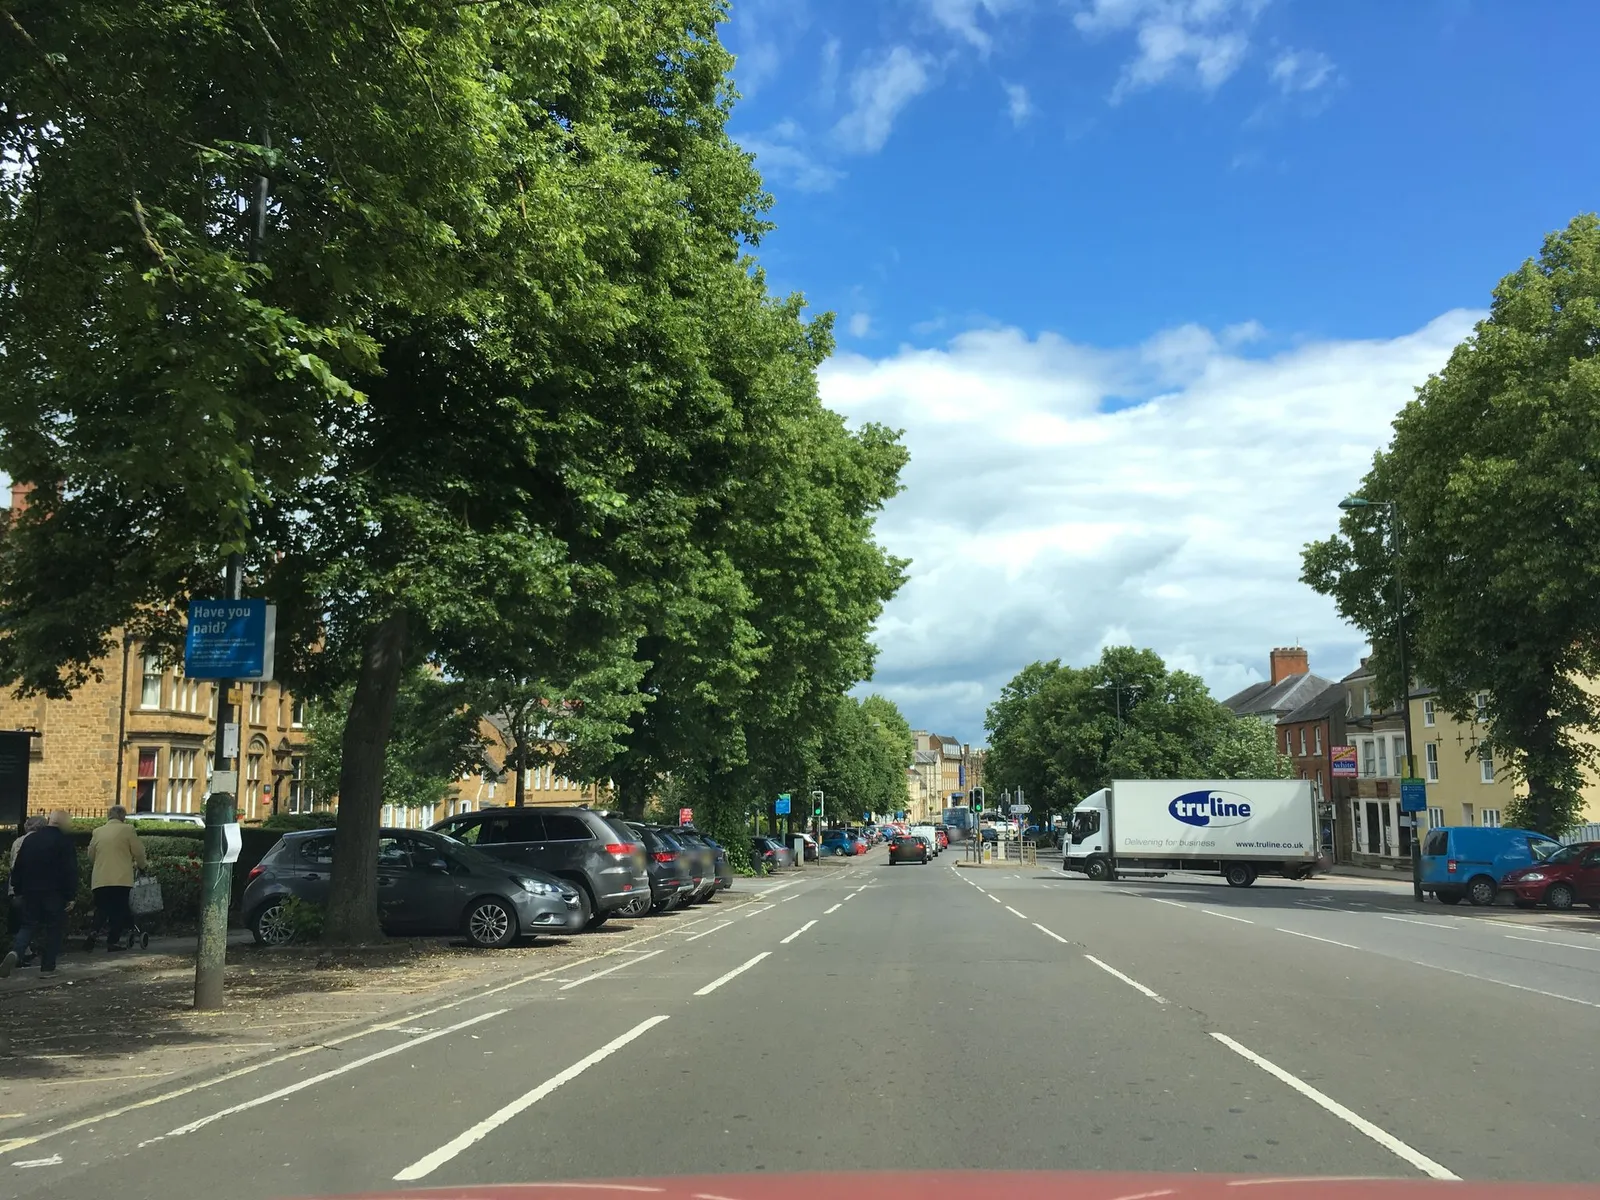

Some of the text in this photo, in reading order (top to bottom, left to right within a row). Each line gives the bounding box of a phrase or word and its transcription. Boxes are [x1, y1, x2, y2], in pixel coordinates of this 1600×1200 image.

[194, 606, 251, 620] Have you
[193, 621, 227, 637] paid?
[1175, 797, 1251, 817] truline
[1124, 837, 1216, 848] Delivering for business
[1236, 841, 1304, 849] www.truline.co.uk
